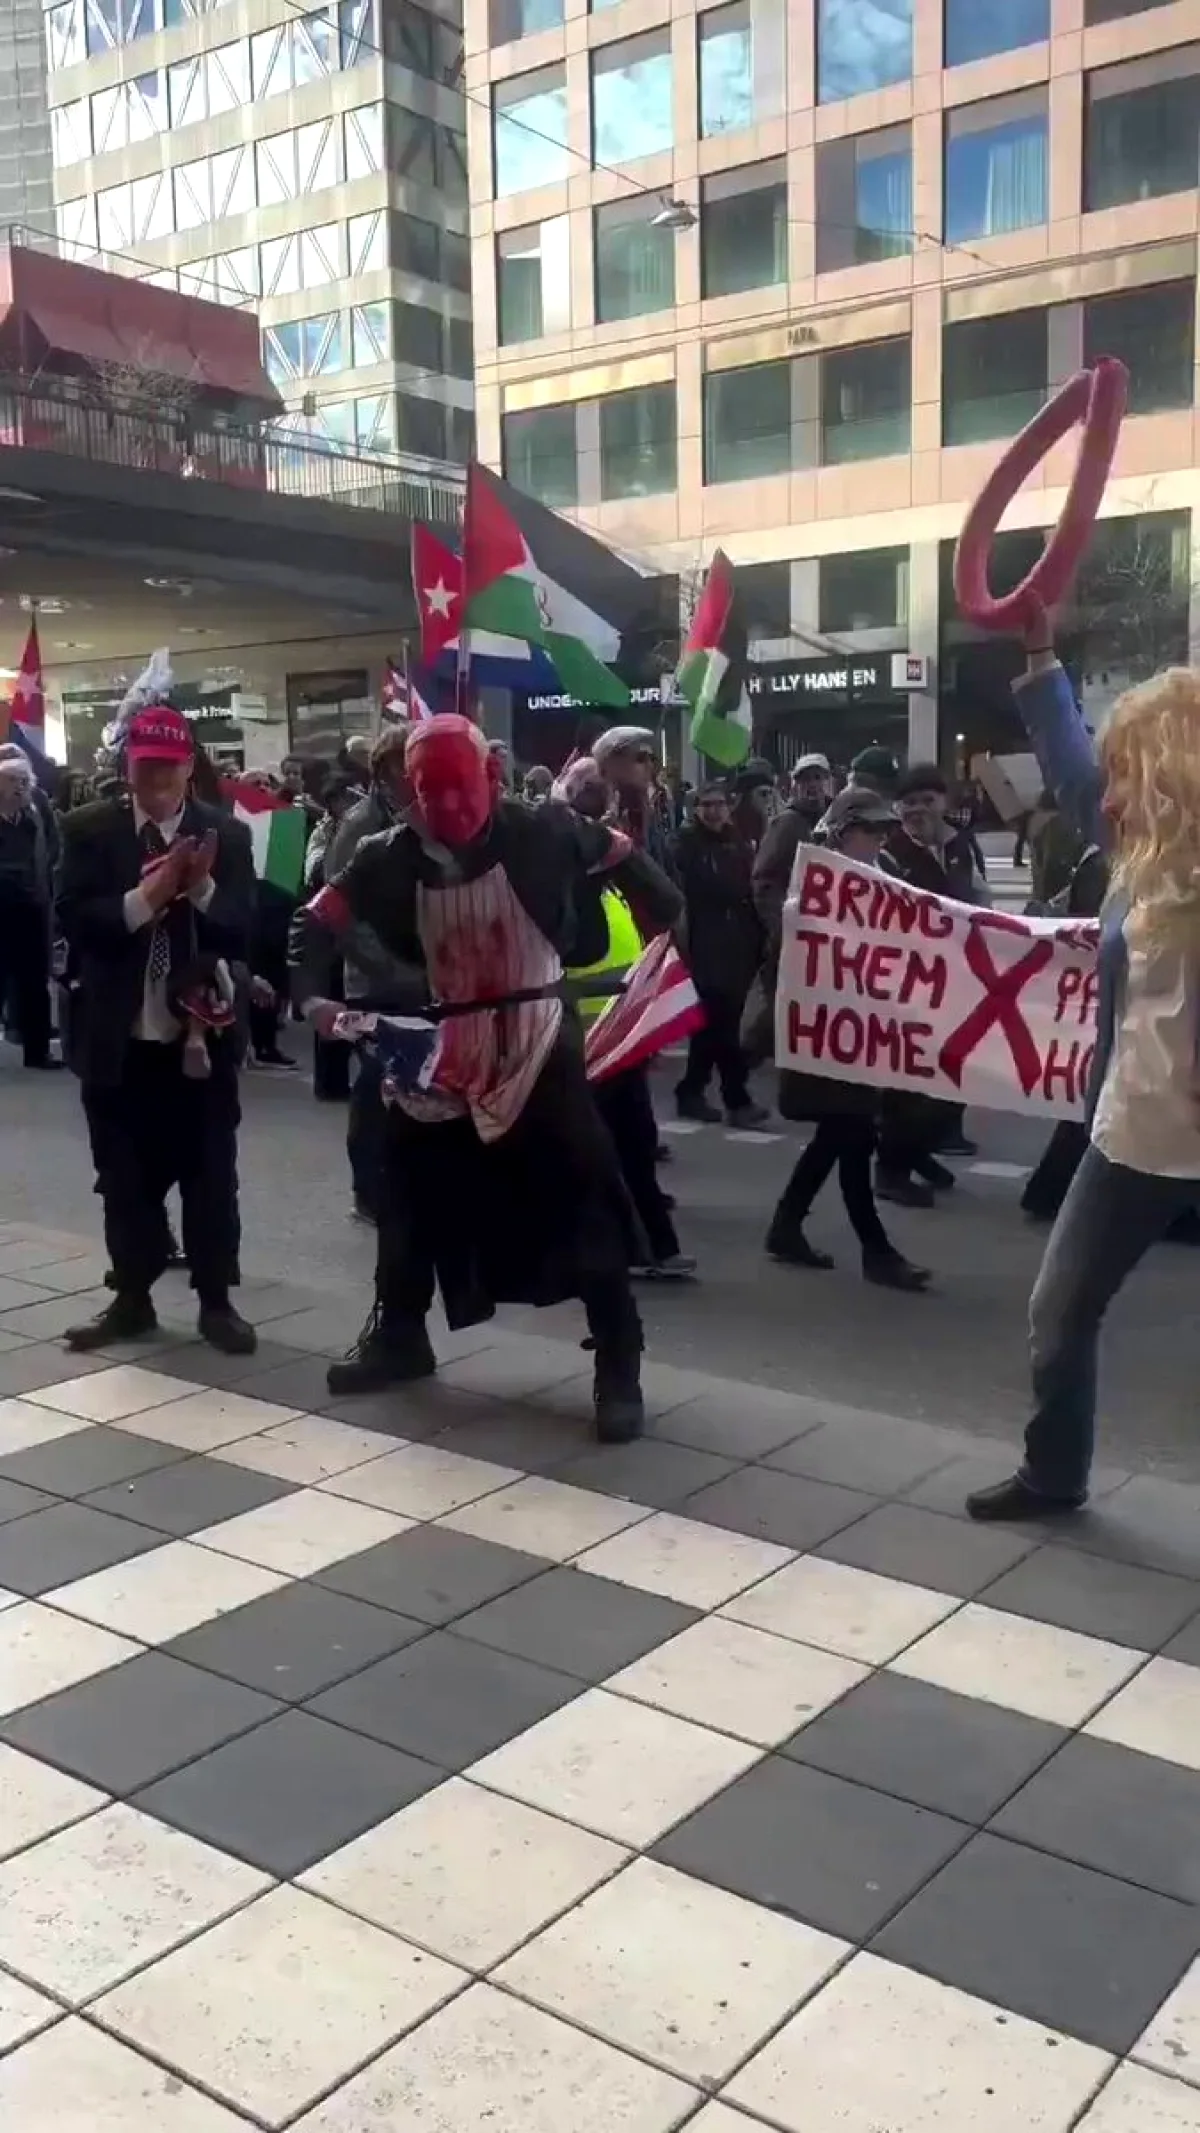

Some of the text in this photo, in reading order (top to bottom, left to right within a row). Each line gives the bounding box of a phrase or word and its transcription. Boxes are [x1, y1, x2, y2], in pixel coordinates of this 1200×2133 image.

[749, 674, 801, 694] HLLY
[800, 861, 954, 939] BRING
[796, 930, 947, 1010] THEM
[788, 1000, 936, 1078] HOME
